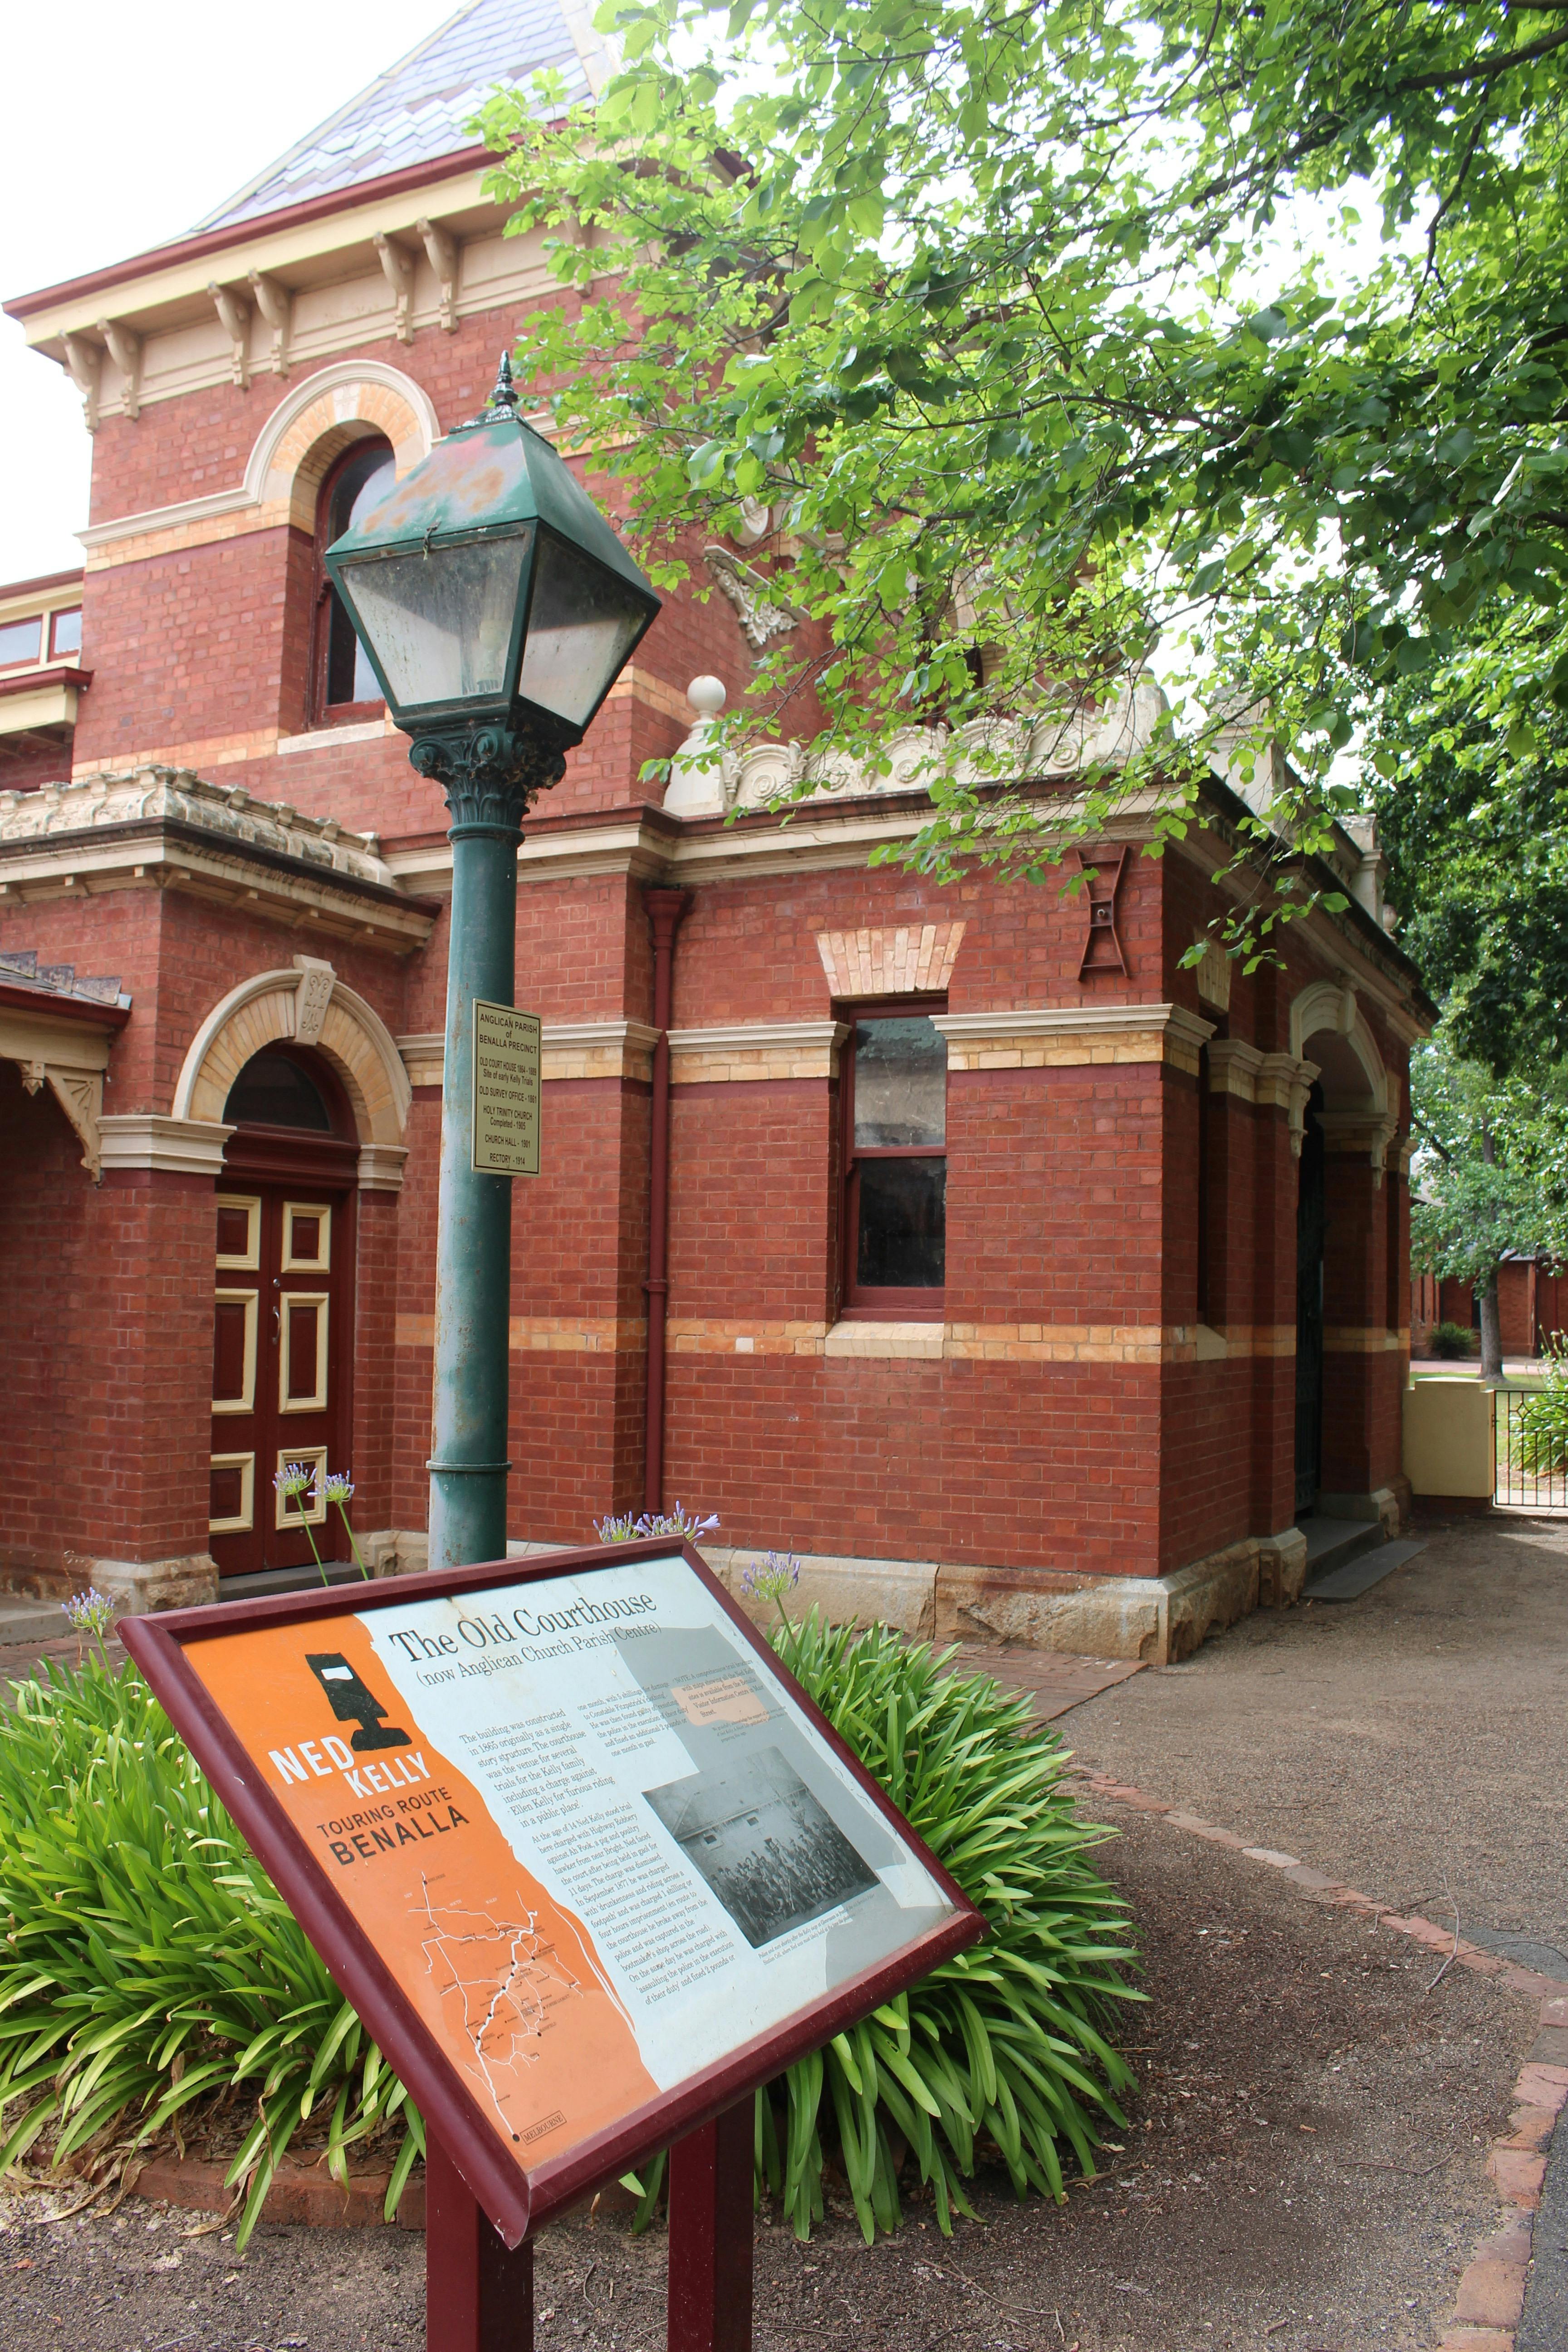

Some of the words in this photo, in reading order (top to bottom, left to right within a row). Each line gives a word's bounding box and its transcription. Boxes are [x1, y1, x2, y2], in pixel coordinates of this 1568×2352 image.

[480, 1013, 513, 1029] ANGLICAN
[515, 1021, 537, 1034] PARISH
[506, 1030, 512, 1039] of
[480, 1034, 507, 1048] BENALLA
[509, 1040, 537, 1054] PRECINCT
[480, 1057, 488, 1067] OLD
[489, 1058, 502, 1069] COURT
[503, 1062, 516, 1072] HOUSE
[517, 1064, 525, 1074] 1864
[483, 1068, 492, 1078] Site
[493, 1070, 497, 1079] of
[499, 1073, 509, 1083] early
[510, 1073, 520, 1085] Kelly
[521, 1076, 533, 1086] Trials
[479, 1086, 489, 1095] OLD
[490, 1087, 508, 1098] SURVEY
[509, 1091, 524, 1102] OFFICE
[528, 1094, 536, 1103] 1861
[483, 1105, 495, 1115] HOLY
[496, 1107, 513, 1117] TRINITY
[514, 1110, 532, 1121] CHURCH
[490, 1117, 513, 1129] Completed
[516, 1121, 526, 1130] 1905
[485, 1134, 504, 1145] CHURCH
[504, 1137, 516, 1147] HALL
[521, 1139, 530, 1148] 1901
[490, 1152, 511, 1163] RECTORY
[515, 1156, 525, 1165] 1914
[387, 1630, 458, 1662] The
[457, 1614, 518, 1648] Old
[513, 1595, 657, 1636] Courthouse
[416, 1669, 455, 1688] (now
[457, 1655, 524, 1677] Anglican
[521, 1639, 575, 1661] Church
[570, 1630, 617, 1651] Parish
[614, 1620, 662, 1640] Centre)
[459, 1734, 477, 1744] The
[475, 1726, 510, 1739] building
[509, 1722, 525, 1730] was
[525, 1708, 566, 1726] constructed
[468, 1748, 479, 1756] in
[478, 1741, 498, 1753] 1865
[499, 1731, 534, 1747] originally
[550, 1721, 572, 1732] single
[268, 1736, 356, 1785] NED
[478, 1757, 498, 1768] story
[498, 1747, 534, 1762] structure.
[532, 1741, 549, 1751] The
[549, 1731, 586, 1746] courthouse
[486, 1770, 503, 1779] was
[502, 1765, 516, 1774] the
[516, 1759, 539, 1769] venue
[539, 1754, 550, 1763] for
[551, 1745, 577, 1759] several
[343, 1751, 431, 1799] KELLY
[494, 1779, 516, 1791] trials
[515, 1776, 528, 1784] for
[528, 1772, 542, 1780] the
[540, 1764, 562, 1776] Kelly
[561, 1757, 585, 1770] family
[502, 1787, 540, 1803] including
[546, 1777, 570, 1789] charge
[570, 1768, 597, 1782] against
[316, 1804, 395, 1838] TOURING
[396, 1786, 453, 1814] ROUTE
[510, 1804, 534, 1816] Ellen
[531, 1796, 554, 1808] Kelly
[553, 1793, 565, 1801] for
[564, 1784, 593, 1797] 'furious
[592, 1776, 615, 1788] riding
[519, 1819, 530, 1828] in
[536, 1808, 560, 1824] public
[559, 1799, 583, 1816] place'.
[538, 1845, 554, 1854] here
[554, 1834, 577, 1848] charged
[577, 1830, 591, 1839] with
[589, 1822, 615, 1834] Highway
[614, 1814, 637, 1825] Robbery
[563, 1824, 569, 1832] of
[575, 1817, 590, 1827] Ned
[588, 1813, 605, 1823] Kelly
[605, 1806, 620, 1817] stood
[619, 1802, 632, 1811] trial
[329, 1805, 470, 1866] BENALLA
[547, 1852, 569, 1864] against
[599, 1837, 610, 1846] pig
[608, 1831, 620, 1841] and
[619, 1826, 639, 1838] poultry
[553, 1862, 576, 1875] hawker
[576, 1857, 591, 1866] from
[591, 1852, 604, 1860] near
[603, 1844, 625, 1855] Bright.
[623, 1838, 637, 1847] Ned
[635, 1832, 651, 1842] faced
[573, 1870, 588, 1881] court
[588, 1865, 602, 1875] after
[601, 1859, 620, 1868] being
[617, 1852, 632, 1862] held
[638, 1845, 650, 1856] gaol
[568, 1887, 578, 1896] 11
[577, 1883, 593, 1892] days.
[591, 1877, 605, 1886] The
[605, 1870, 624, 1881] charge
[635, 1852, 663, 1868] dismissed.
[583, 1887, 615, 1903] September
[614, 1879, 629, 1890] 1877
[648, 1862, 670, 1876] charged
[584, 1906, 599, 1916] with
[635, 1885, 647, 1895] and
[646, 1880, 664, 1891] riding
[663, 1873, 680, 1883] across
[523, 2114, 564, 2141] MELBOURNE
